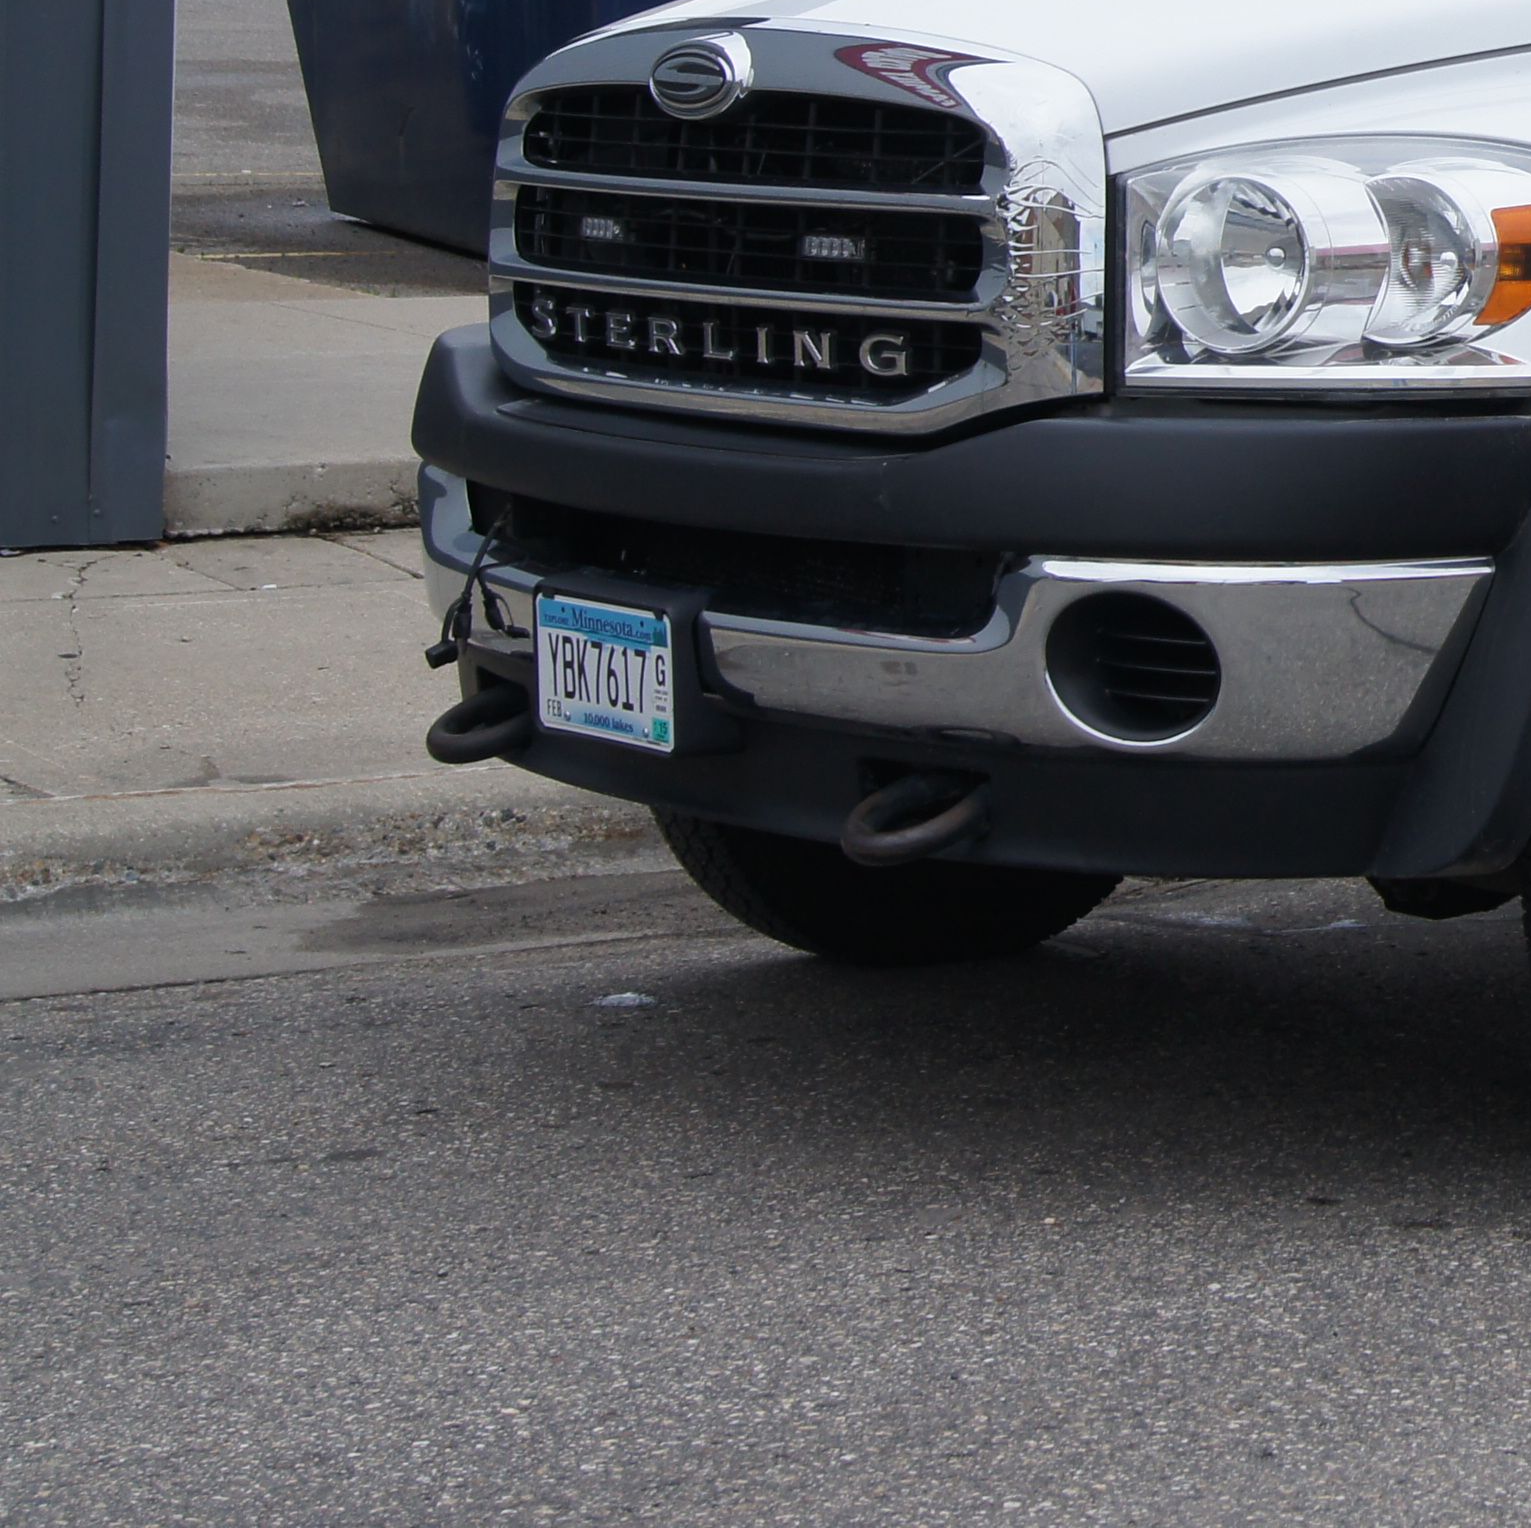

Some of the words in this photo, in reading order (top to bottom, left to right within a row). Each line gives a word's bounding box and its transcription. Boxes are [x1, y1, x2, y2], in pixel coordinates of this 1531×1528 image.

[531, 289, 909, 376] STERLING
[548, 632, 647, 714] YBK7617
[655, 654, 666, 687] G
[547, 698, 562, 718] FEB
[584, 712, 610, 728] 10,000
[612, 716, 634, 733] lakes
